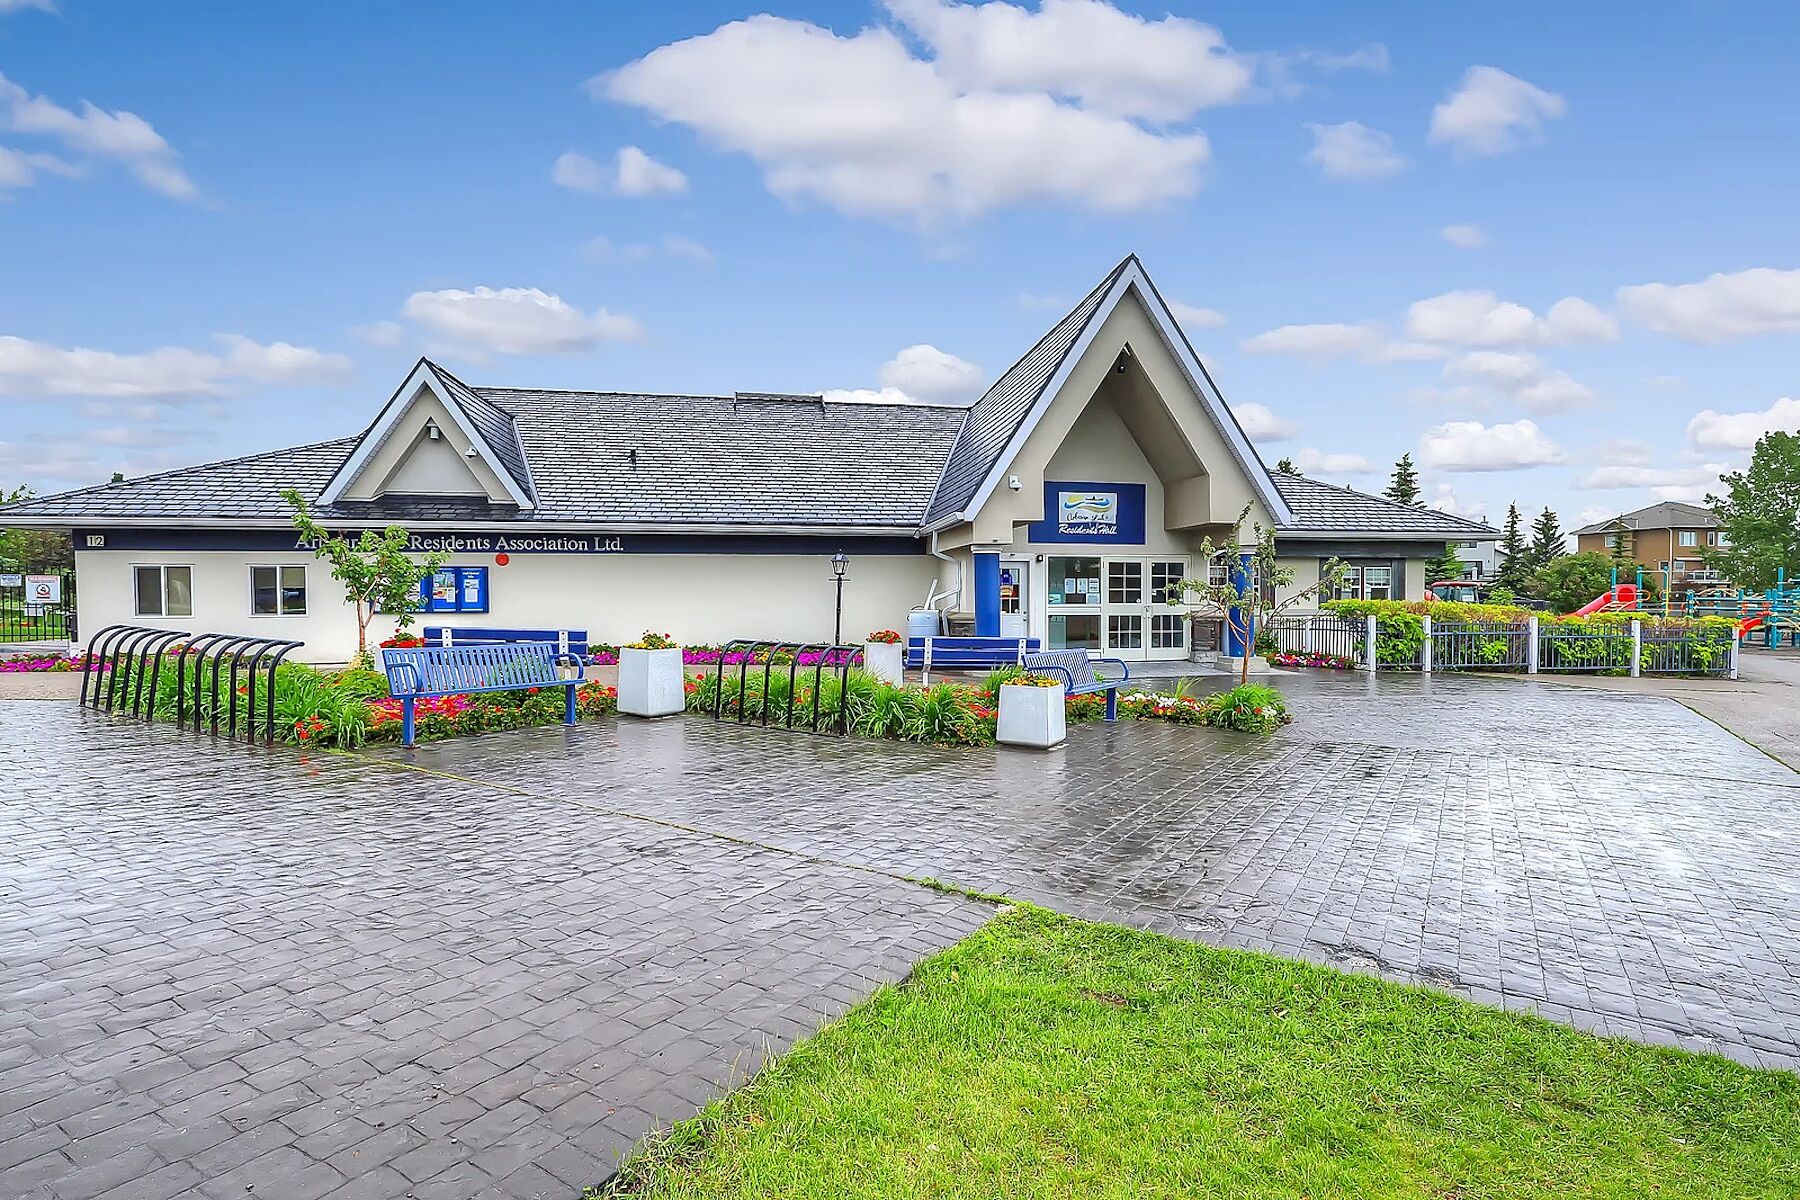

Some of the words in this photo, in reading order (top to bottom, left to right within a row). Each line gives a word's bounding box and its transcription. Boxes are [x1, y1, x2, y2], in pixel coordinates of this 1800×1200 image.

[88, 536, 103, 546] 12
[410, 535, 491, 550] Residents
[495, 536, 588, 551] Association
[593, 537, 624, 551] Ltd.
